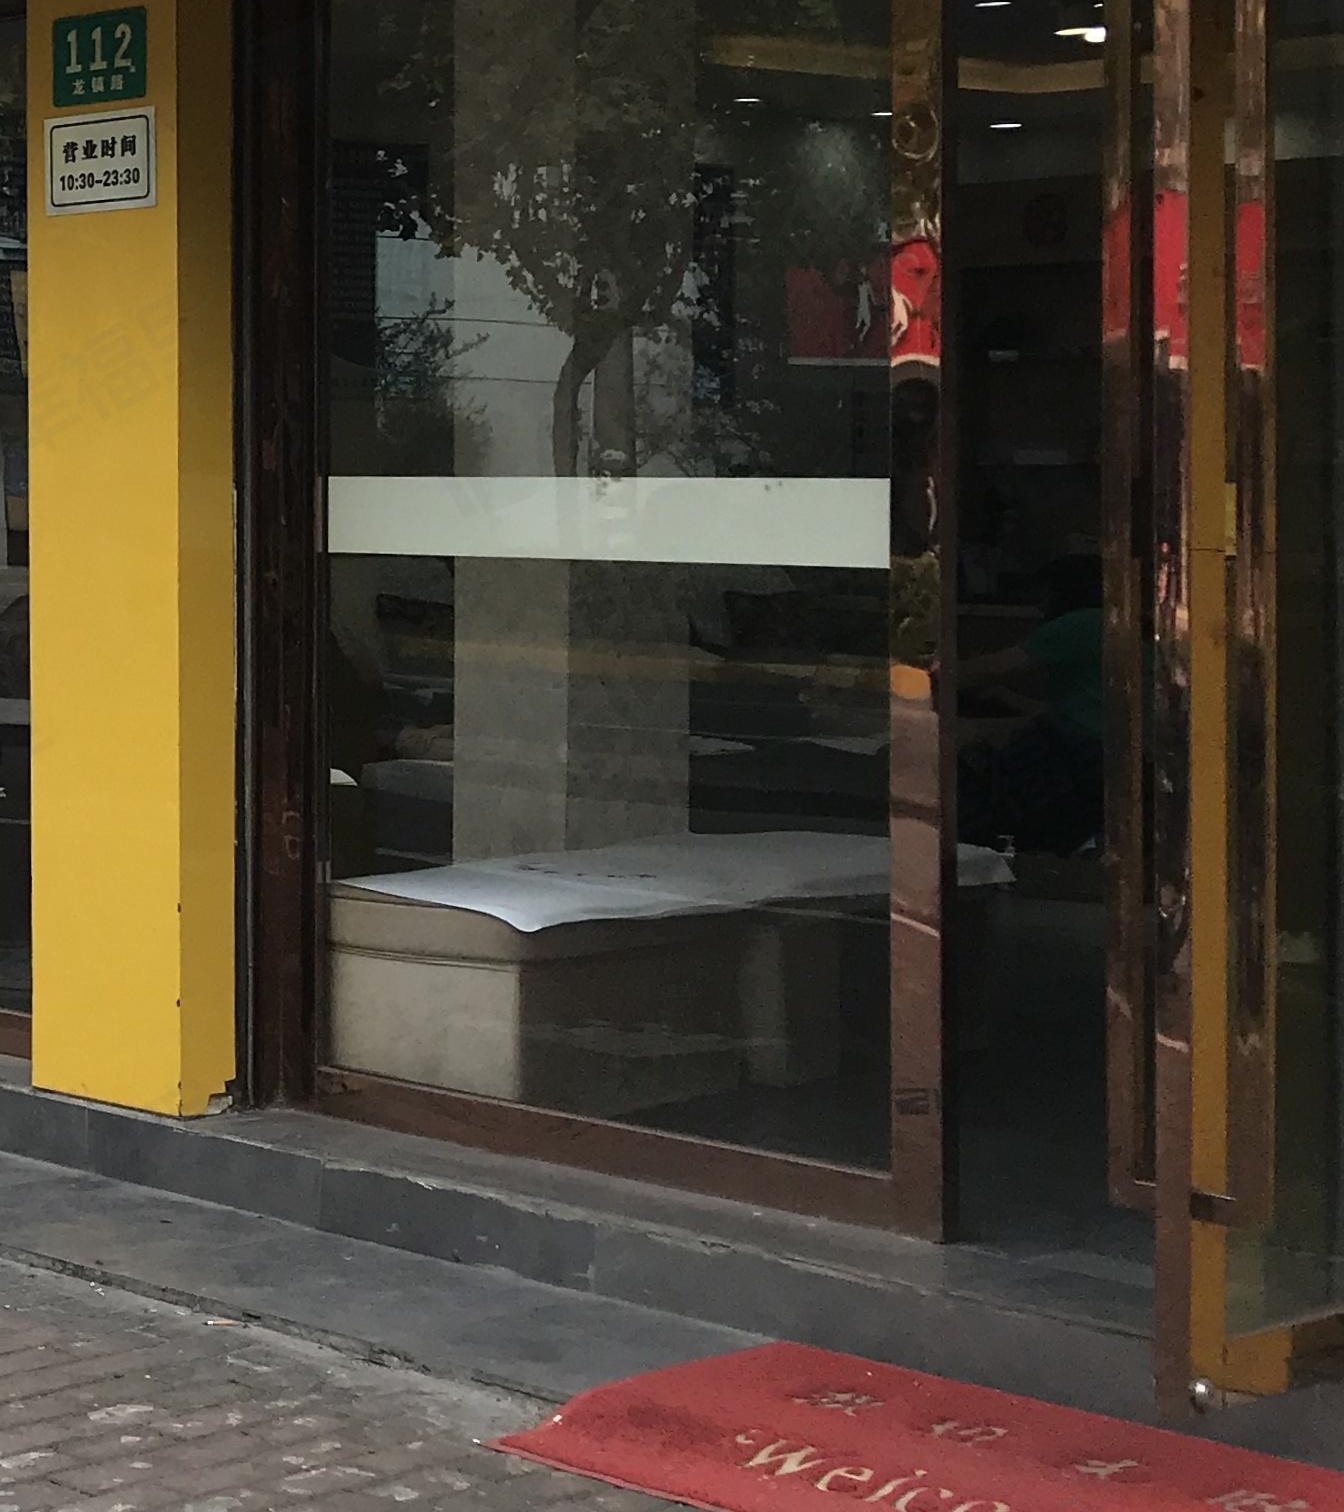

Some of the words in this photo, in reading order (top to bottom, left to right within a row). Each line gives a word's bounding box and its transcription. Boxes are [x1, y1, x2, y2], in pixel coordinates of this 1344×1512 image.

[66, 23, 133, 74] 112
[72, 75, 125, 95] 龙镇路
[62, 135, 137, 164] 营业时间
[59, 168, 140, 191] 10:30-23:30
